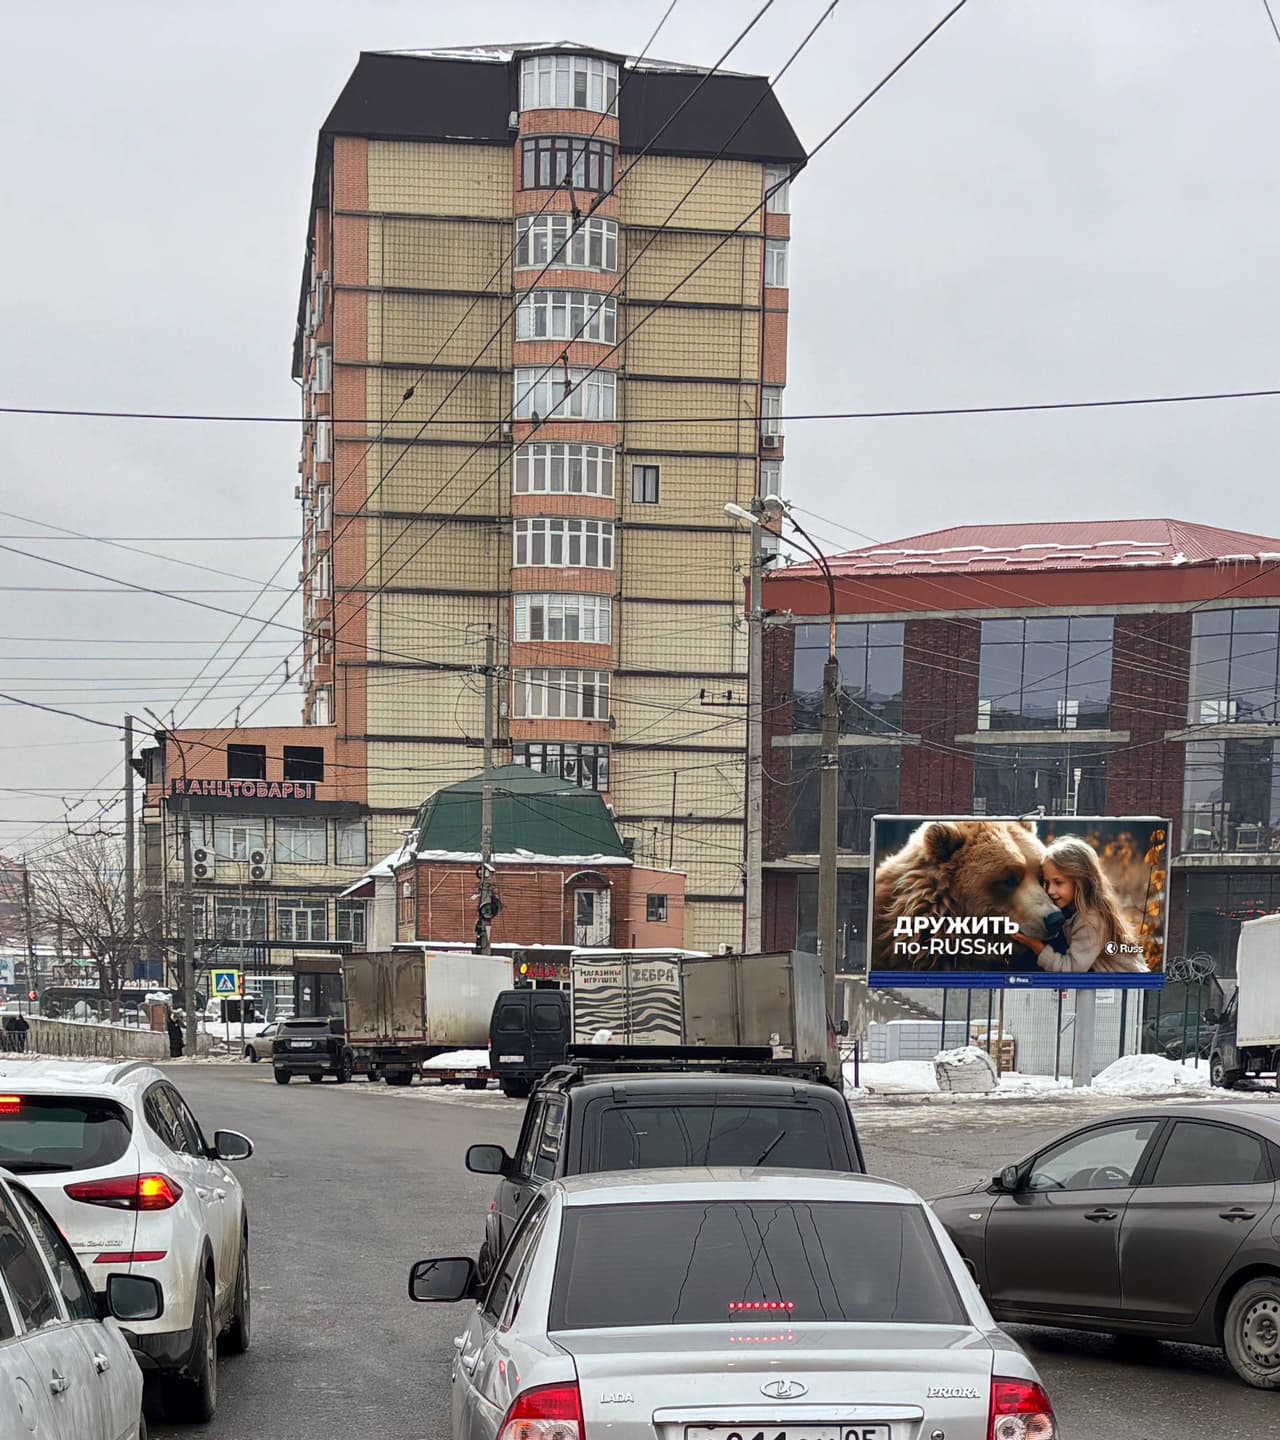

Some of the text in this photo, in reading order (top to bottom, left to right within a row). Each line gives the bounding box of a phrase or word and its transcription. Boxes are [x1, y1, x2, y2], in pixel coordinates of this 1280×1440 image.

[176, 780, 312, 798] КАНЦТОВАРЫ
[893, 916, 1020, 937] ДРУЖИТЬ
[893, 938, 1013, 955] по-RUSSки
[1120, 944, 1144, 954] Russ
[600, 1393, 634, 1404] LADA
[927, 1386, 981, 1399] PRIORA
